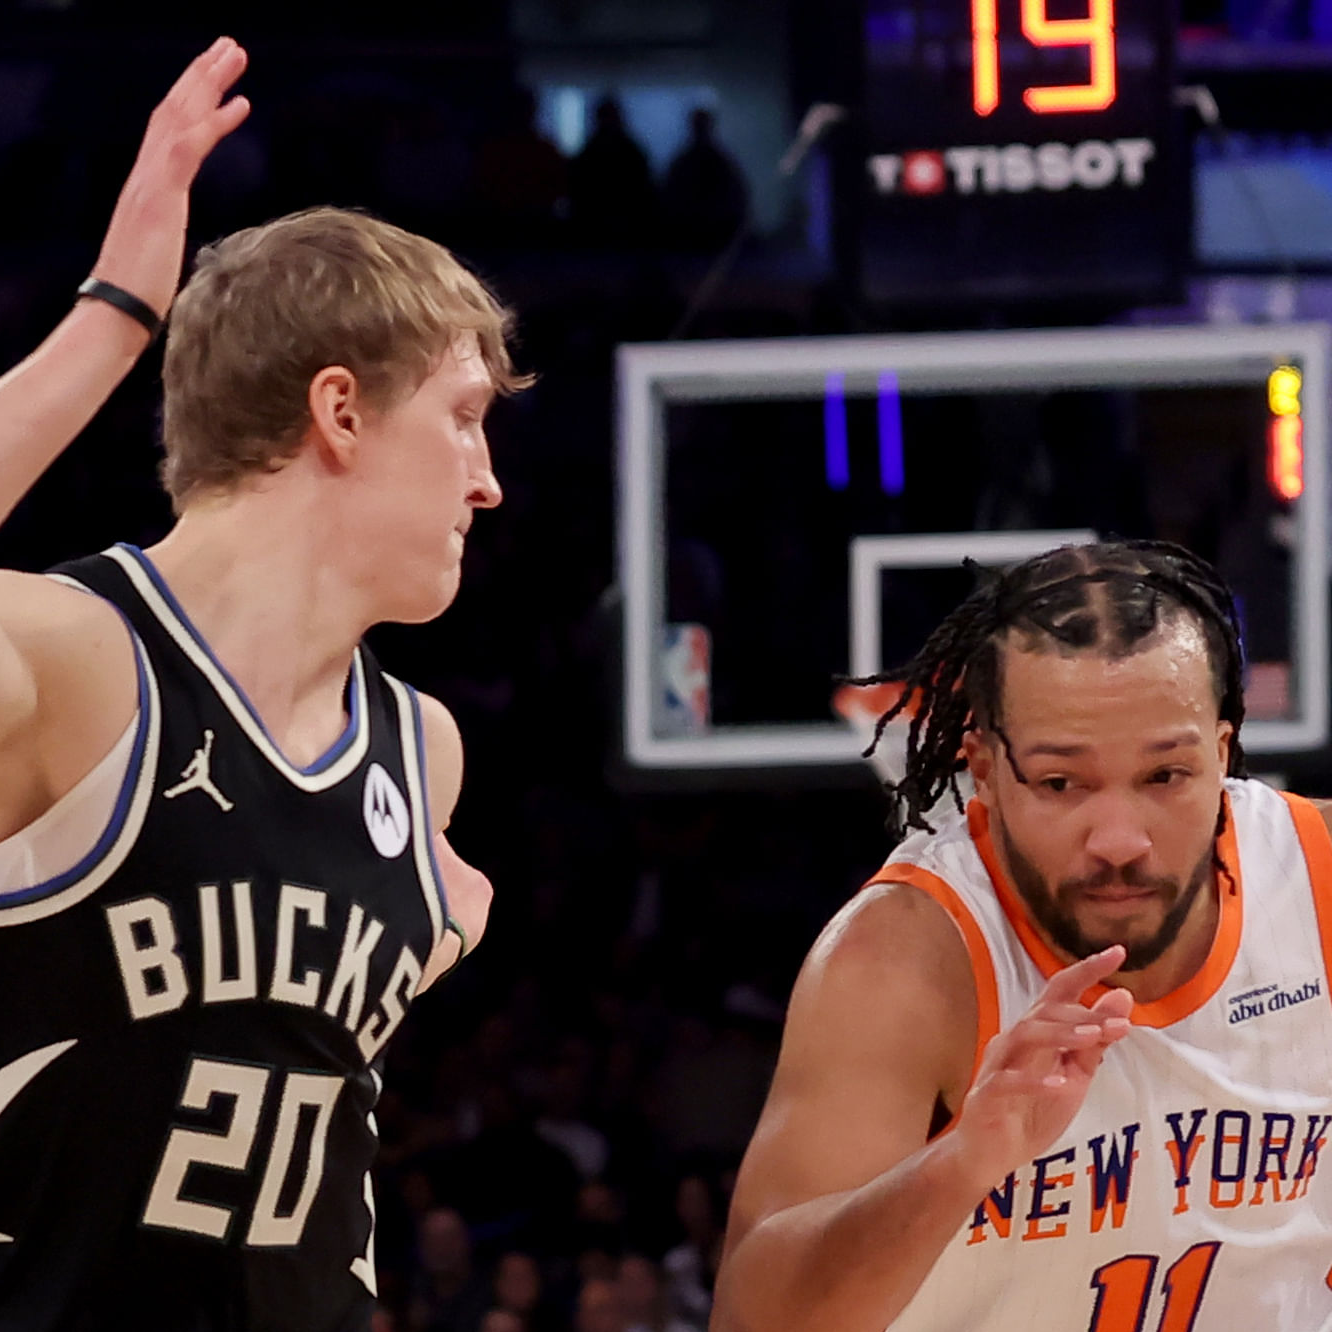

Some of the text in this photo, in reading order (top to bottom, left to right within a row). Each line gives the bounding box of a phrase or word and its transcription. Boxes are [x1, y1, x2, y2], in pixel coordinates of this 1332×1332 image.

[971, 0, 1117, 117] 19
[945, 137, 1155, 195] TISSOT
[105, 880, 422, 1064] BUCKS
[1229, 978, 1321, 1025] abu dhabi
[142, 1055, 346, 1247] 20
[967, 1123, 1141, 1246] NEW
